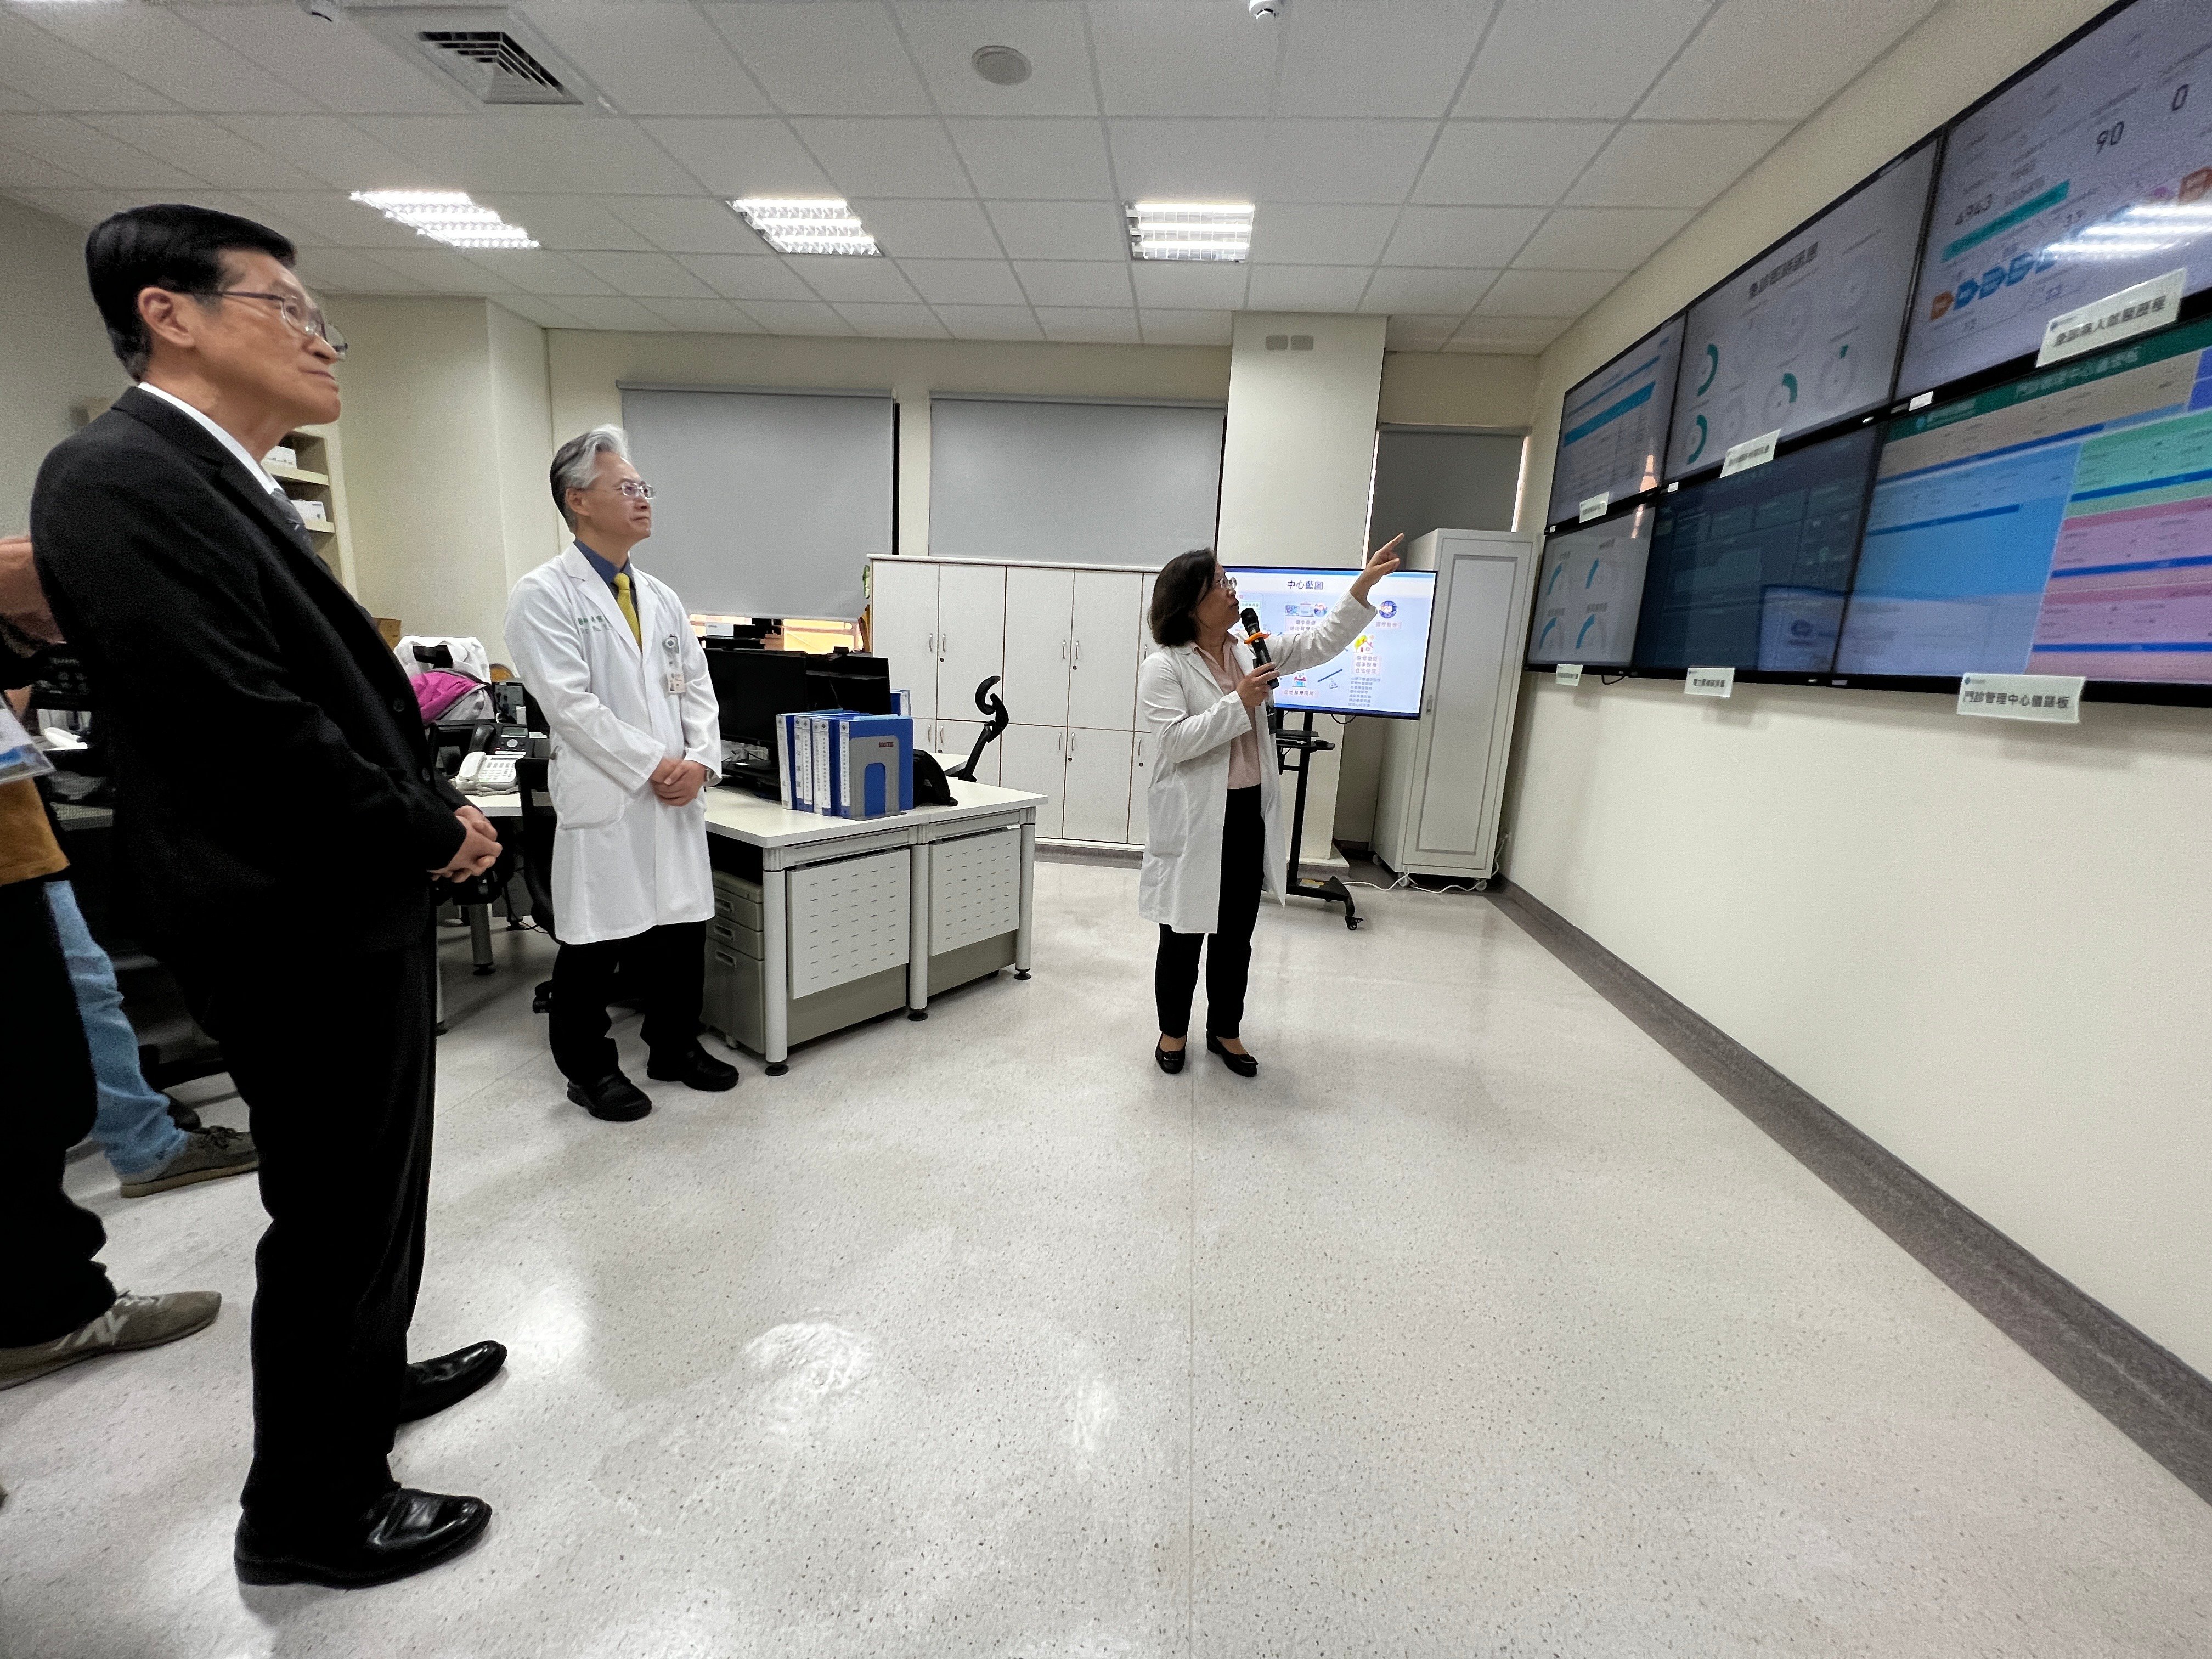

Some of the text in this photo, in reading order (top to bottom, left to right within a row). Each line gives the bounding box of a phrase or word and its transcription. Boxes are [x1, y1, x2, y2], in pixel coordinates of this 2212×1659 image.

[2171, 84, 2189, 111] 0
[2096, 121, 2125, 157] 90
[1287, 580, 1323, 590] 中心藍圖
